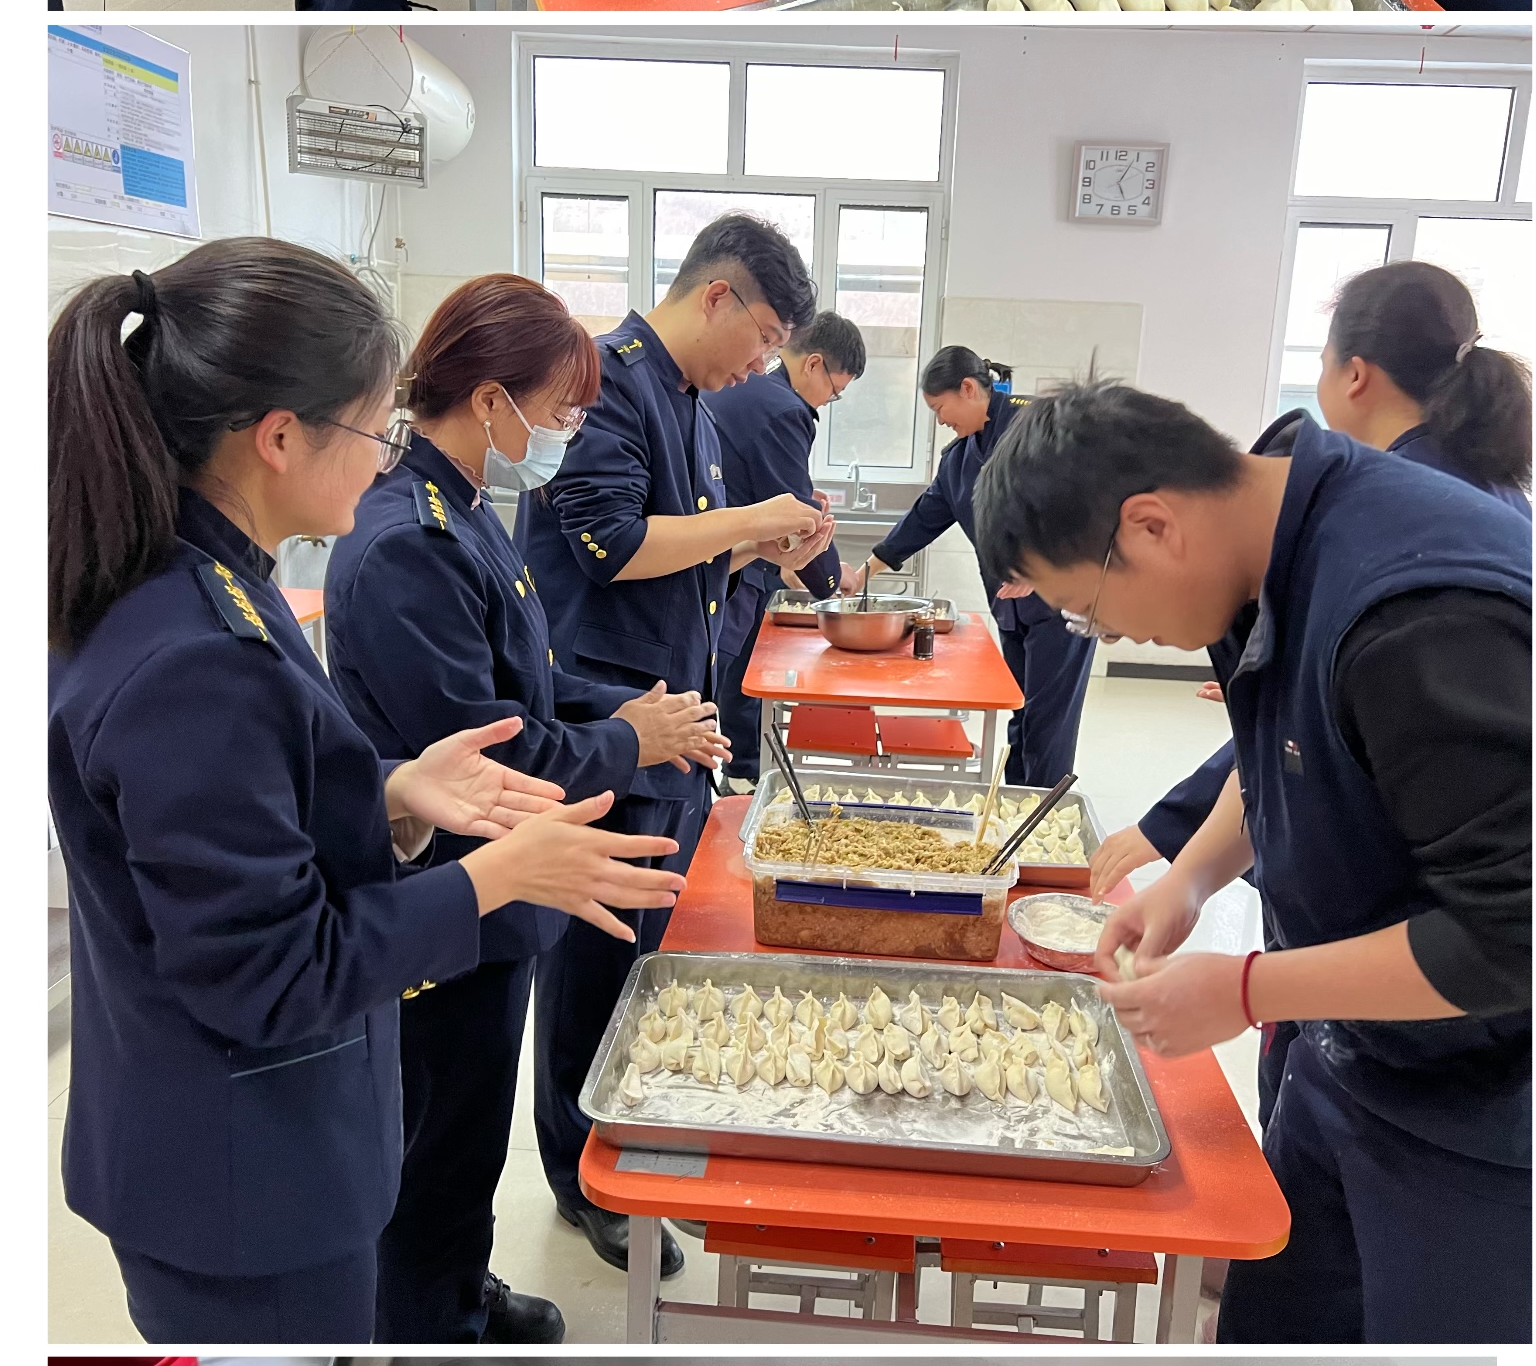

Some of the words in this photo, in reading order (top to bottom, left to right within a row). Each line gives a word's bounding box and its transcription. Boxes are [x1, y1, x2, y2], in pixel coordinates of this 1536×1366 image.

[1100, 151, 1109, 161] 11
[1114, 150, 1128, 161] 12
[1136, 152, 1140, 162] 1
[1085, 159, 1096, 170] 10
[1145, 161, 1155, 172] 2
[1082, 177, 1091, 187] 9
[1145, 178, 1155, 189] 3
[1082, 194, 1091, 204] 8
[1141, 196, 1151, 206] 4
[1095, 203, 1104, 214] 7
[1110, 205, 1120, 215] 6
[1127, 205, 1137, 215] 5
